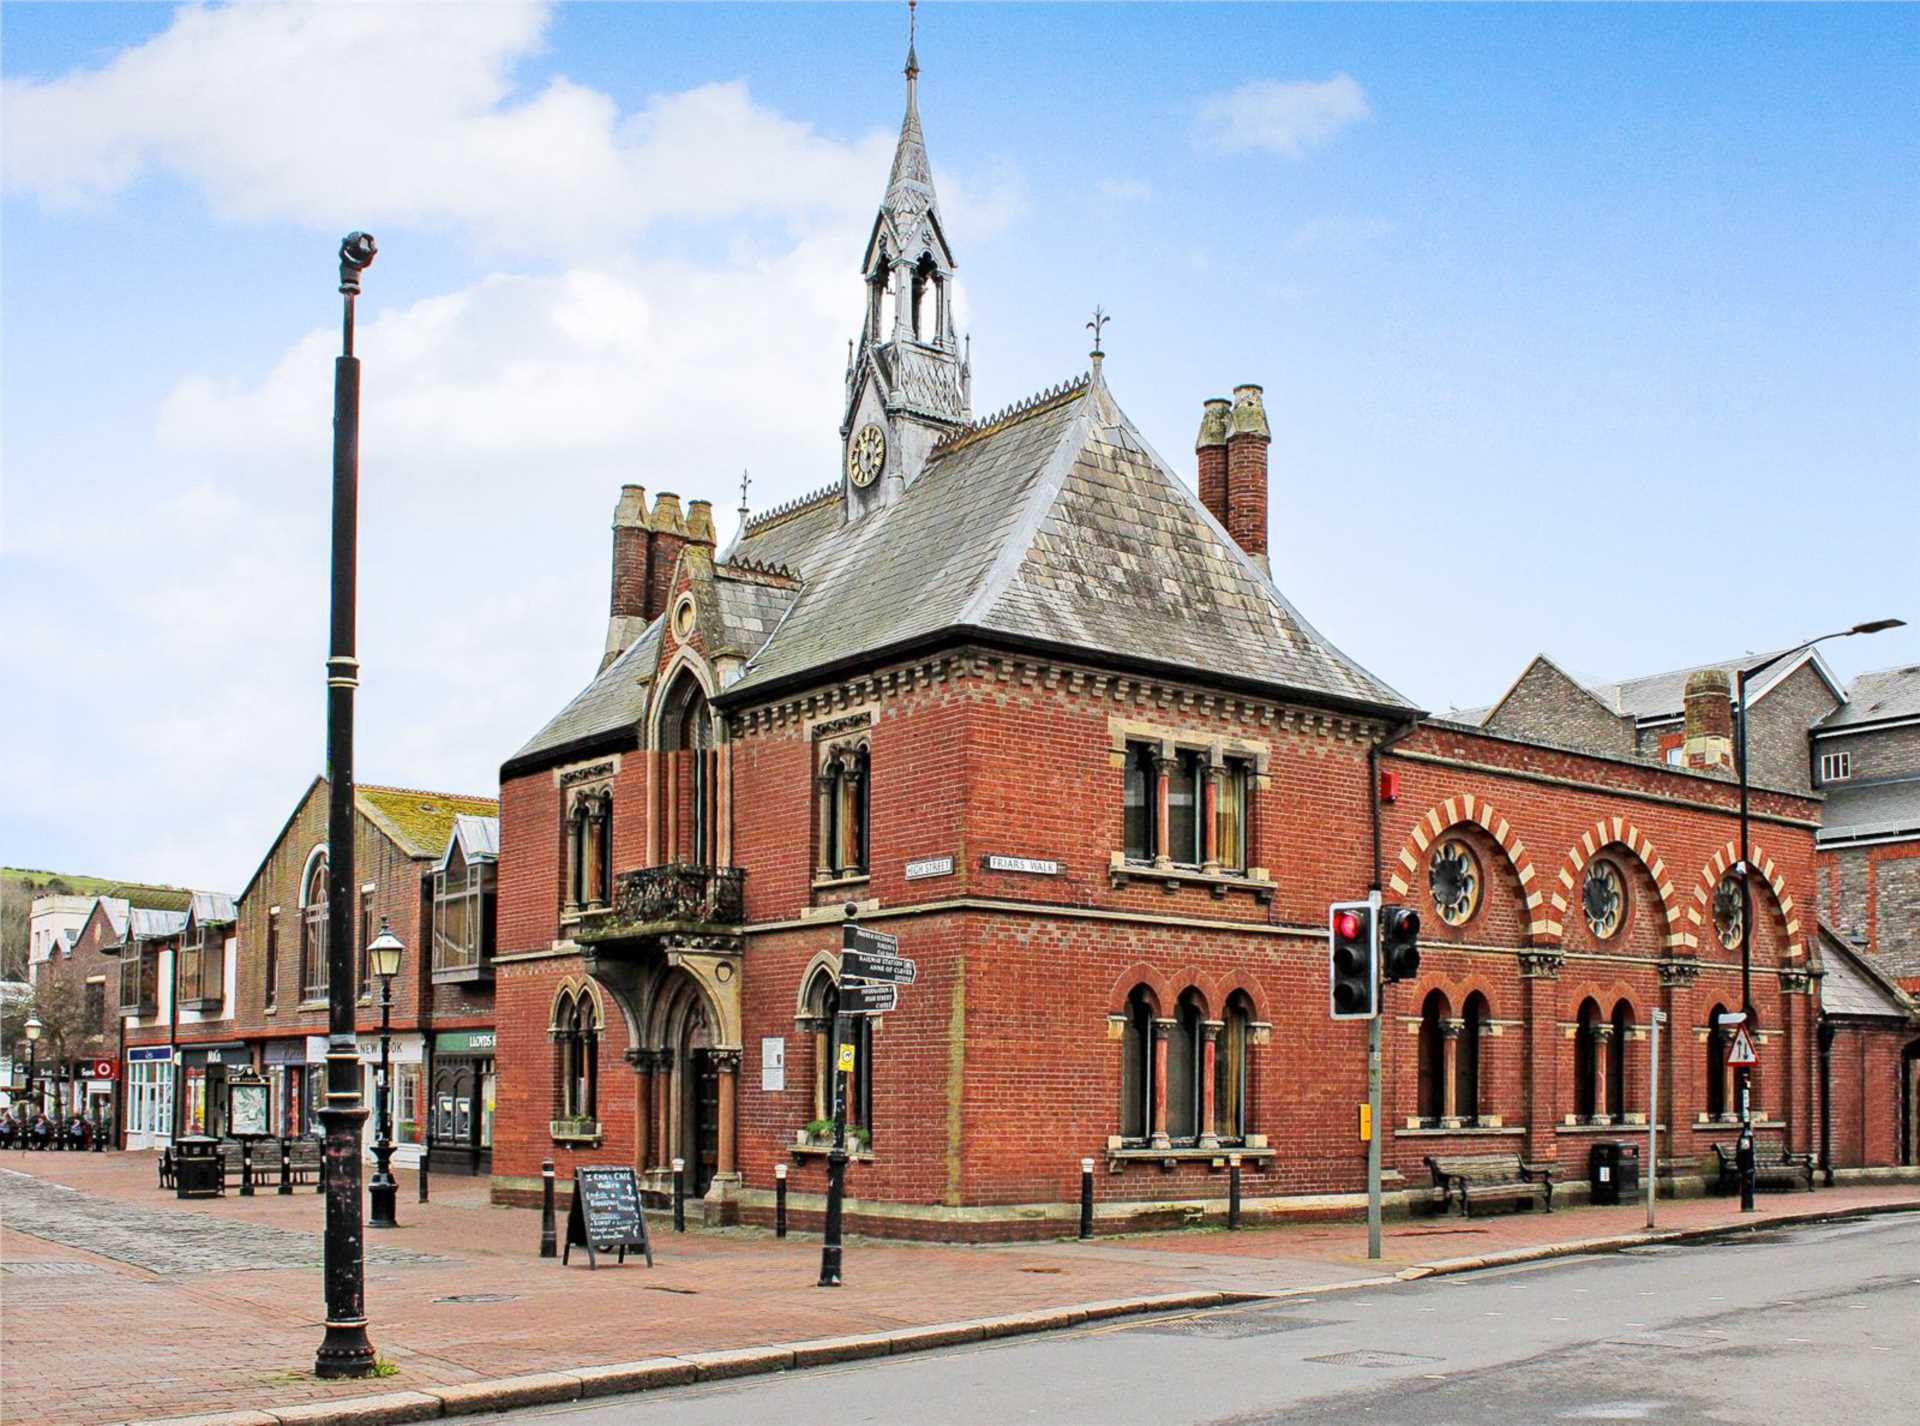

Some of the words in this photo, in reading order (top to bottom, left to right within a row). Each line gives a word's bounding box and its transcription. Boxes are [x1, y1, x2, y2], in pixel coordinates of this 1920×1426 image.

[908, 865, 924, 877] HIGH
[925, 860, 949, 874] STREET
[992, 857, 1025, 869] FRIARS
[1031, 860, 1054, 872] WALK
[882, 958, 903, 966] STATION
[360, 1040, 377, 1053] NEW
[469, 1034, 492, 1048] LLOYDS
